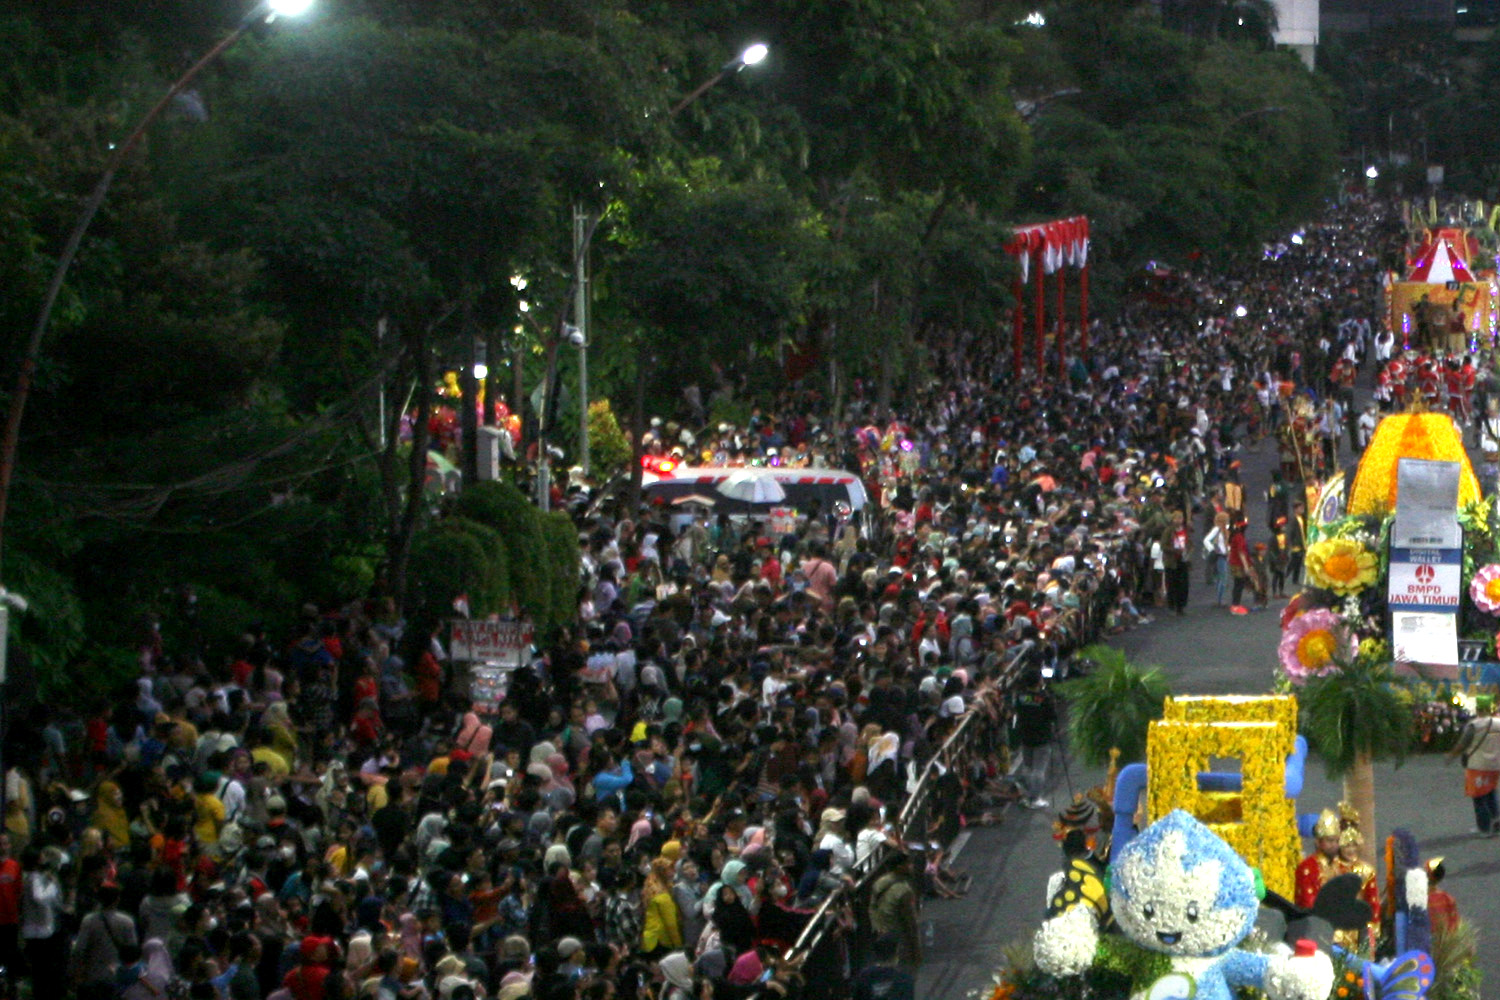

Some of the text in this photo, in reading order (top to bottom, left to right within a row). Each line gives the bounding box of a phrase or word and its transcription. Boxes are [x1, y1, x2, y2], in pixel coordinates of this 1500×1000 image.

[1407, 584, 1441, 594] BMPD
[1390, 593, 1458, 605] JAWA TIMUR
[1463, 647, 1482, 661] 11
